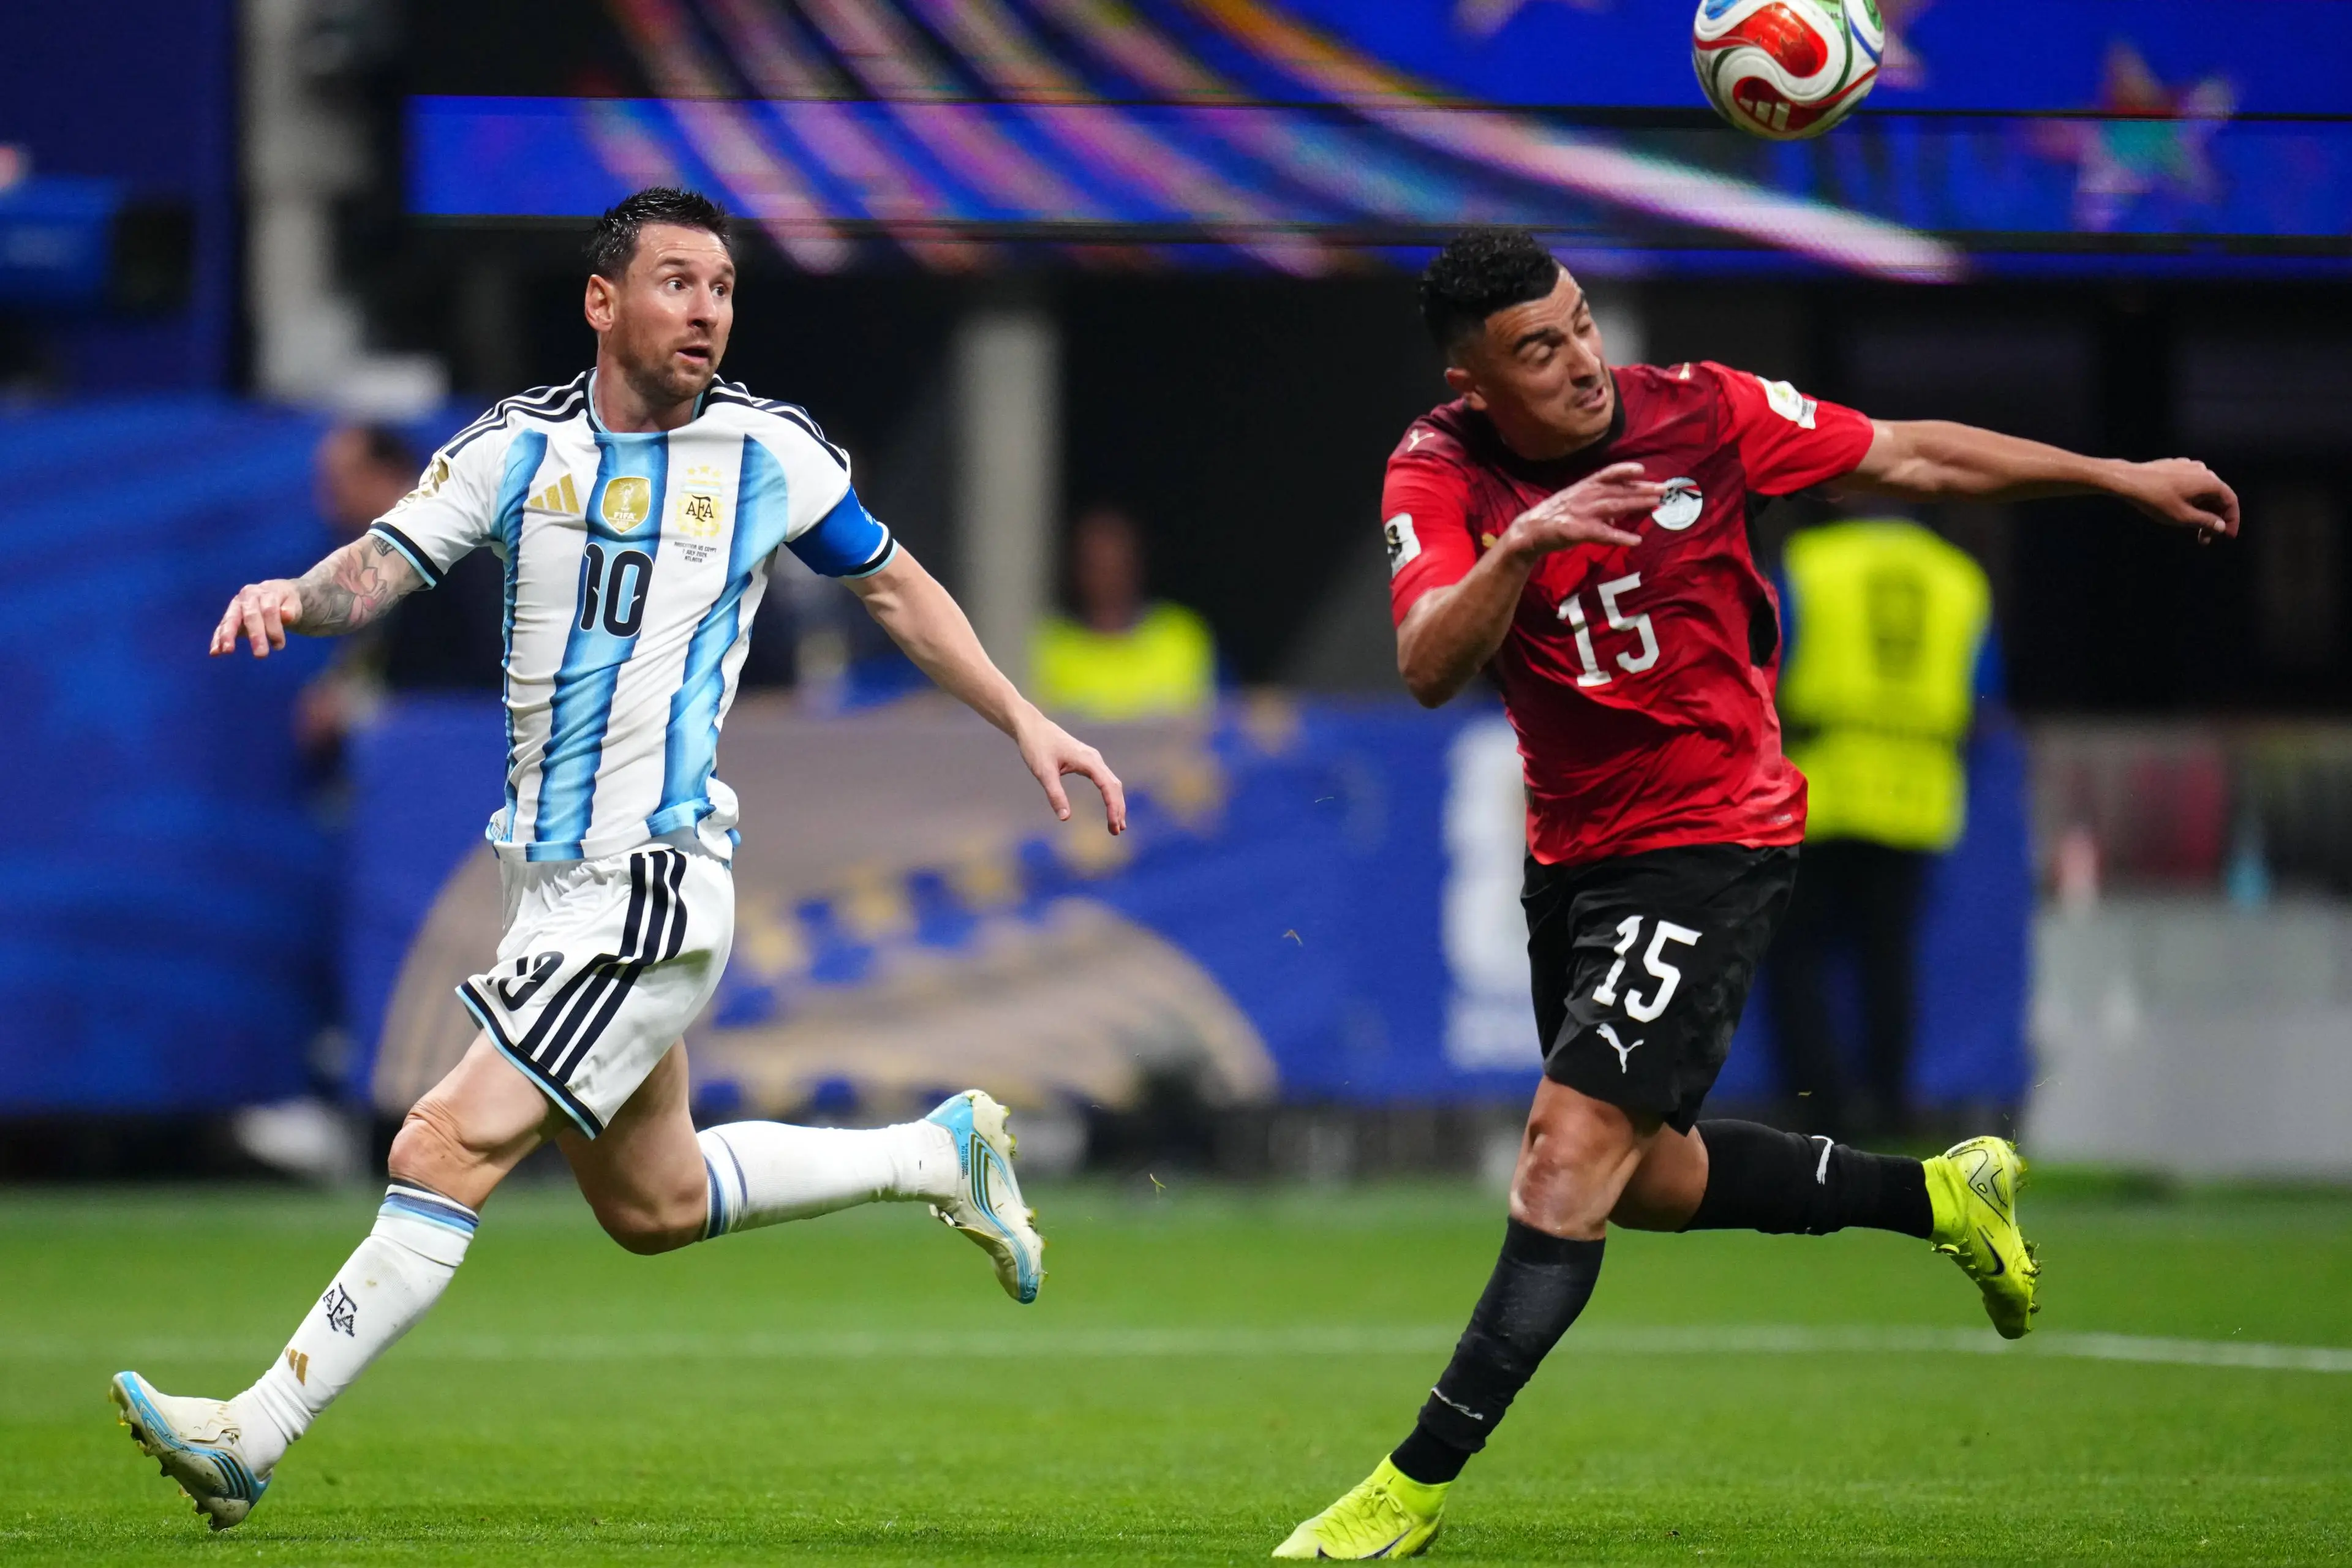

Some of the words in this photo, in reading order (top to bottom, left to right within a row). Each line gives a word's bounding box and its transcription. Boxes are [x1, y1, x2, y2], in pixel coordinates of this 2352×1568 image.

[614, 511, 635, 520] FIFA
[685, 494, 714, 522] AFA
[579, 541, 654, 639] 10
[1557, 571, 1660, 687] 15
[1592, 915, 1703, 1023] 15
[323, 1282, 358, 1337] AFA
